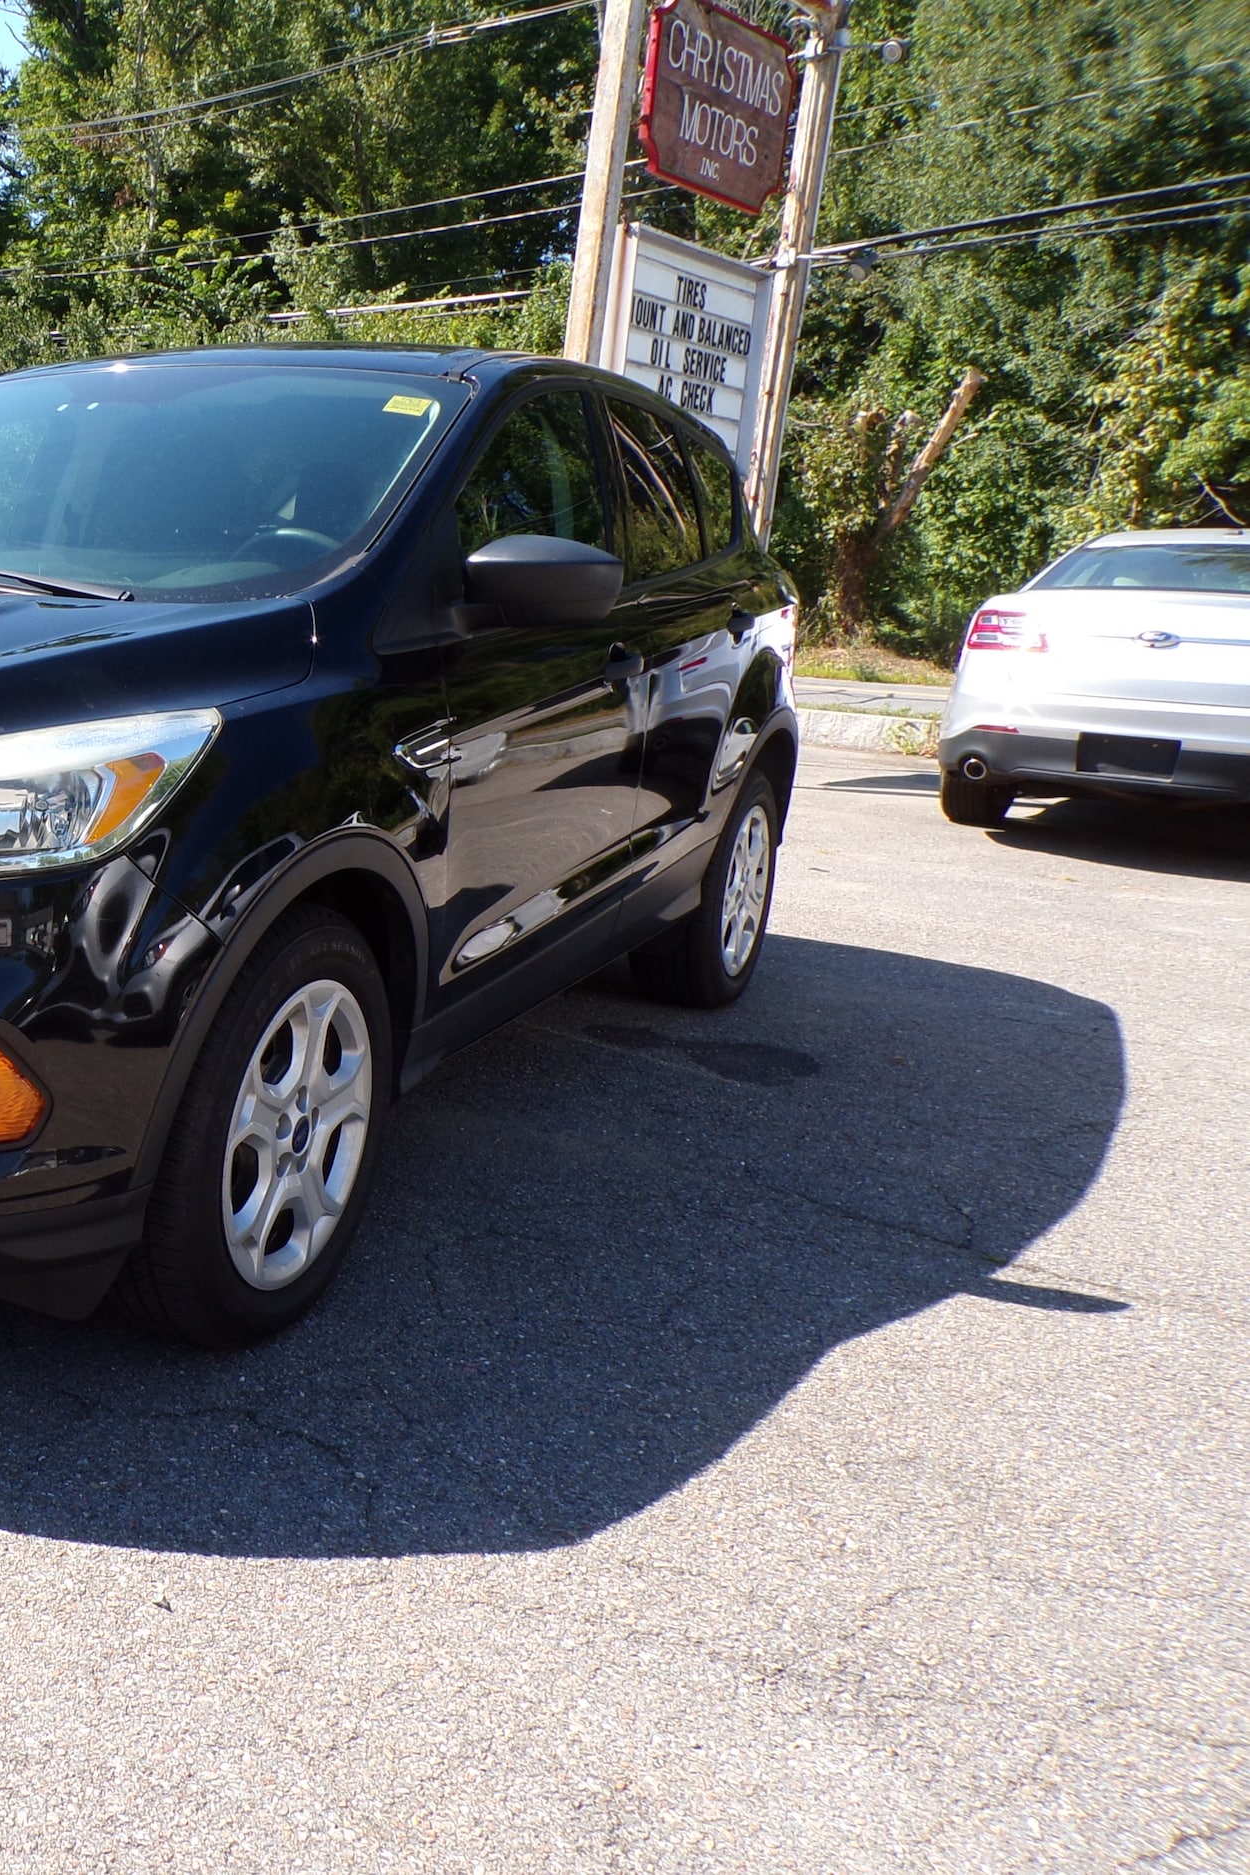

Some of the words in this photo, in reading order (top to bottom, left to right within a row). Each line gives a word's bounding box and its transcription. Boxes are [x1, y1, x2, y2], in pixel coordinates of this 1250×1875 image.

[668, 19, 785, 117] CHRISTMAS
[679, 93, 759, 166] MOTORS
[677, 276, 707, 309] TIRES
[631, 296, 666, 332] OUNT
[672, 309, 695, 340] AND
[697, 317, 751, 356] BALANCED
[651, 338, 670, 368] OIL
[683, 347, 727, 383] SERVICE
[659, 375, 672, 399] AC
[681, 381, 715, 413] CHECK
